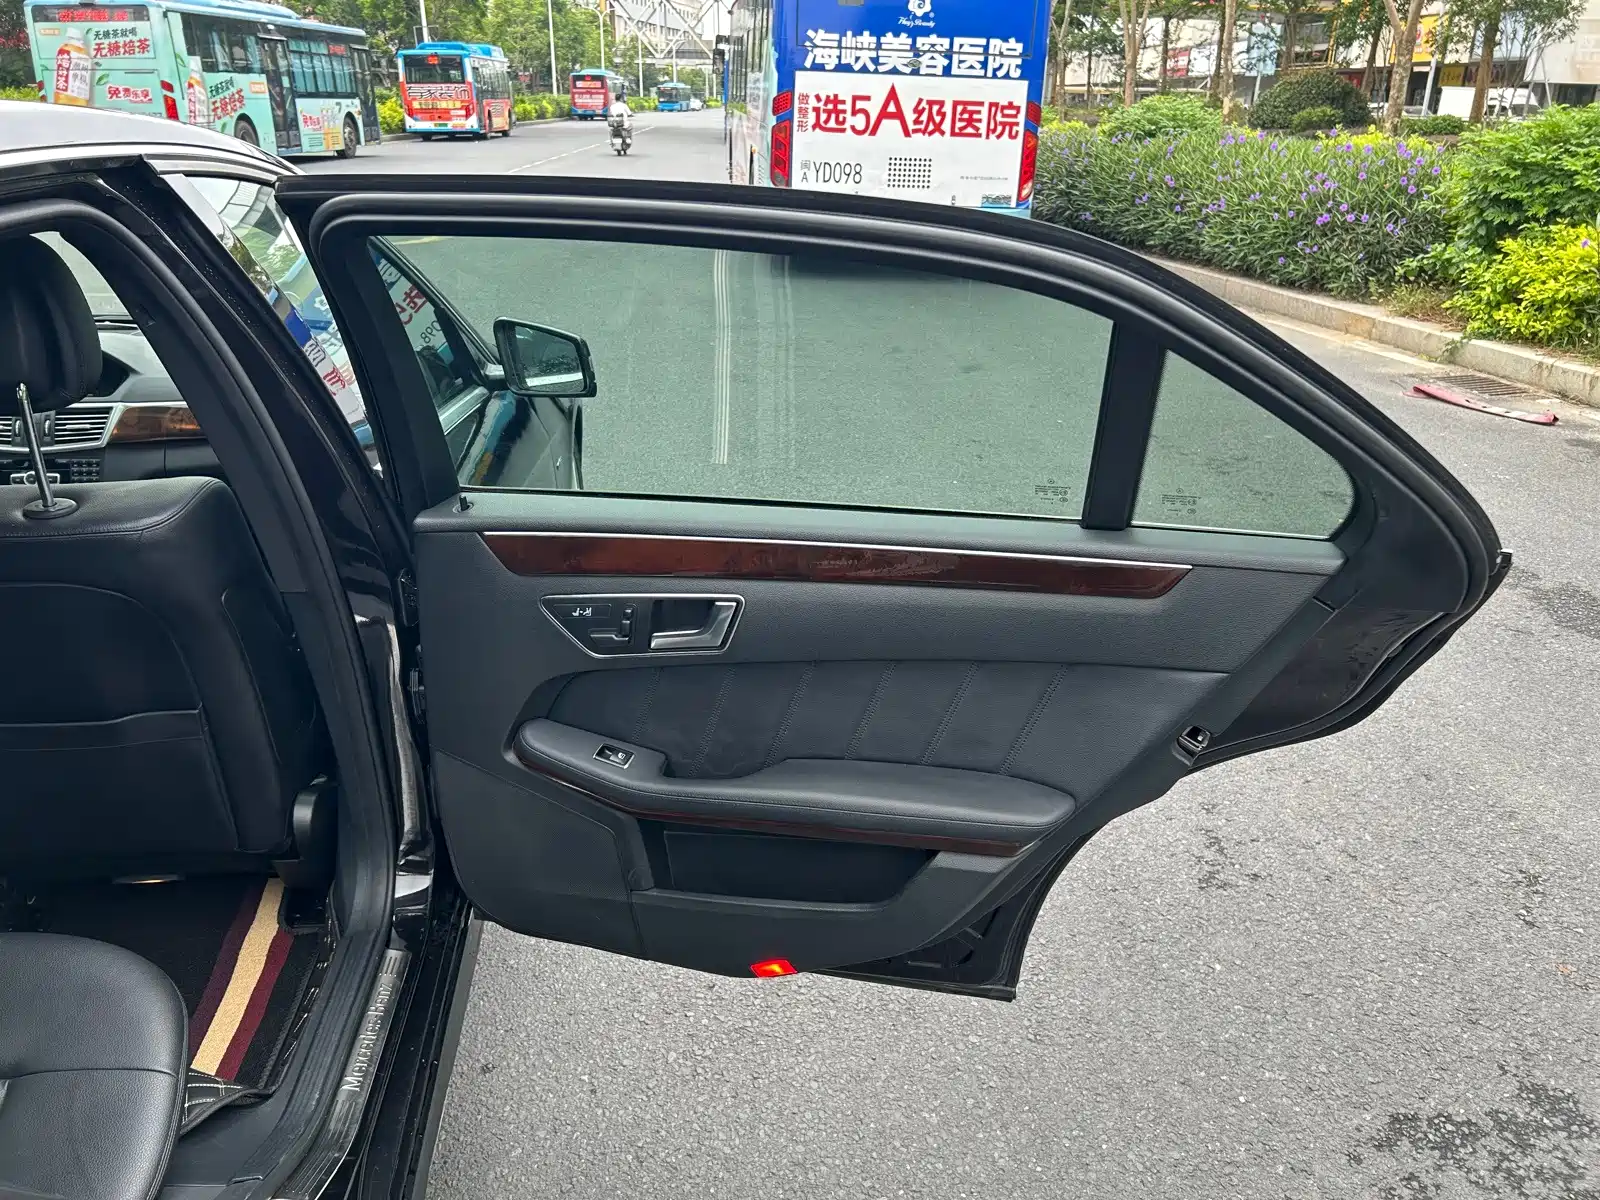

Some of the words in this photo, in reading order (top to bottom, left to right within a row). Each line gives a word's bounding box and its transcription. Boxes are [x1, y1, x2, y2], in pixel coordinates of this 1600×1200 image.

[93, 38, 150, 58] 无糖焙茶
[803, 28, 1023, 78] 海峡美容医院
[797, 92, 810, 133] 做整形
[811, 82, 1021, 140] 选5A级医院
[813, 161, 863, 185] YD098
[340, 983, 393, 1092] Mercedes-Benz
